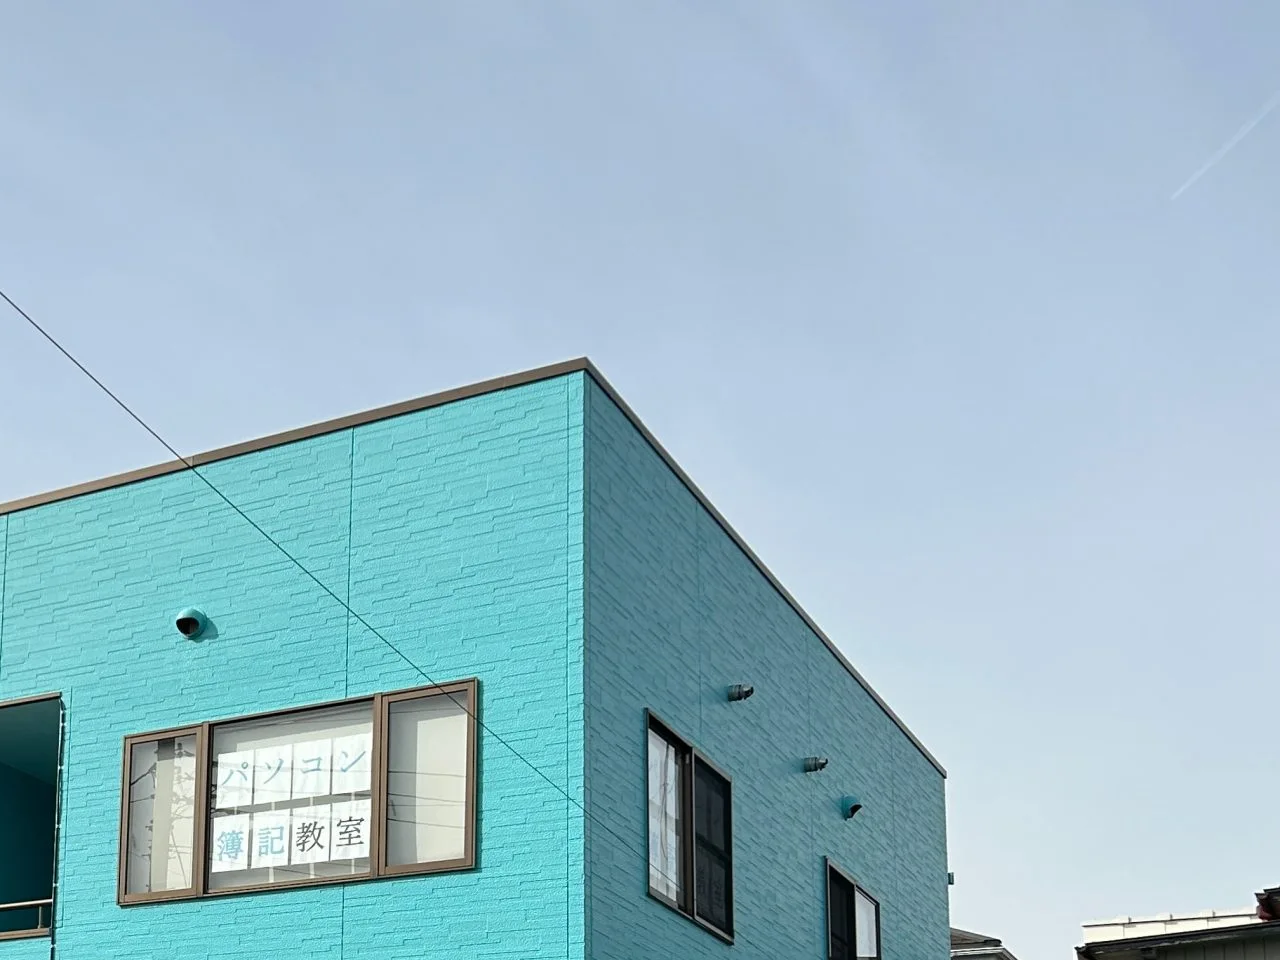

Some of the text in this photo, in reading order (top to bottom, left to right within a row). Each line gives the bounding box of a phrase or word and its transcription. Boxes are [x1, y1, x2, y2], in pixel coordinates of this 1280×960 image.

[221, 750, 366, 785] パソコン
[217, 816, 366, 862] 簿記教室
